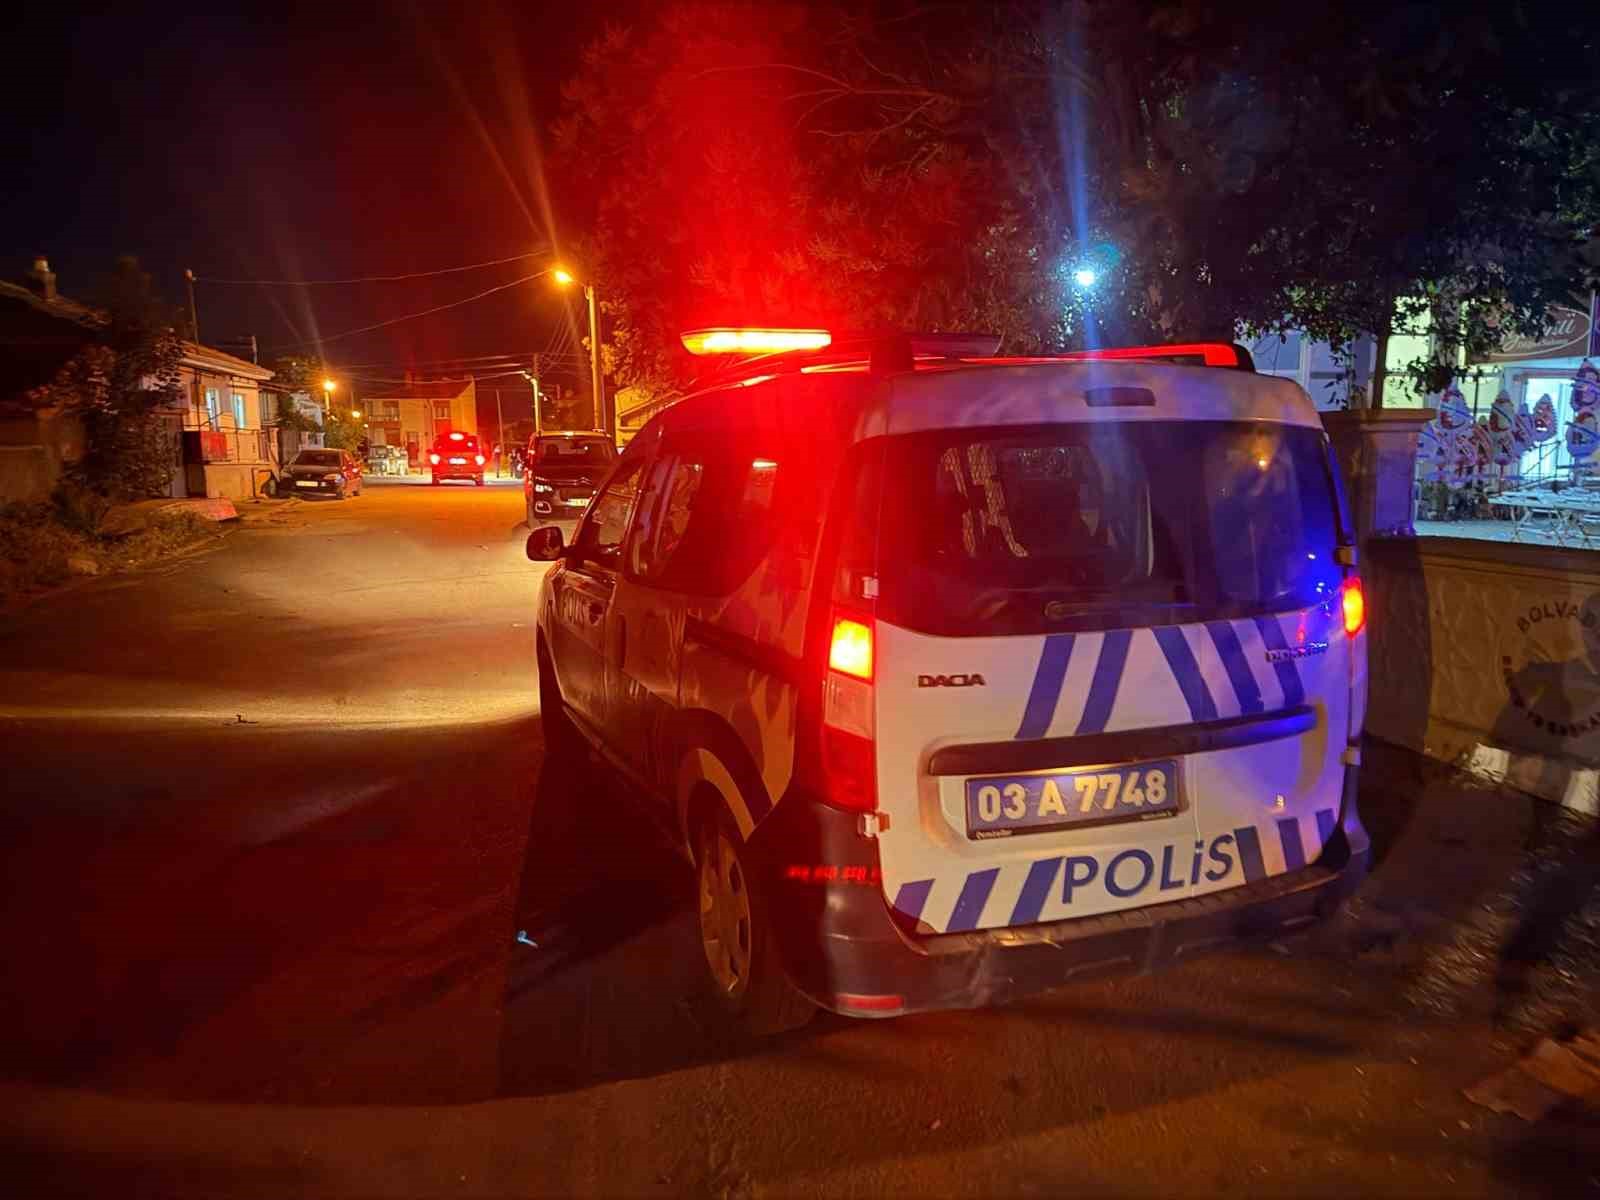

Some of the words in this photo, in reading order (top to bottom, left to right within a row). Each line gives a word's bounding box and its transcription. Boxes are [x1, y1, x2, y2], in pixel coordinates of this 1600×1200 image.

[1516, 600, 1597, 633] BOLVA
[918, 674, 985, 688] DACIA
[977, 784, 1026, 822] 03
[1037, 780, 1068, 817] A
[1074, 769, 1167, 813] 7748
